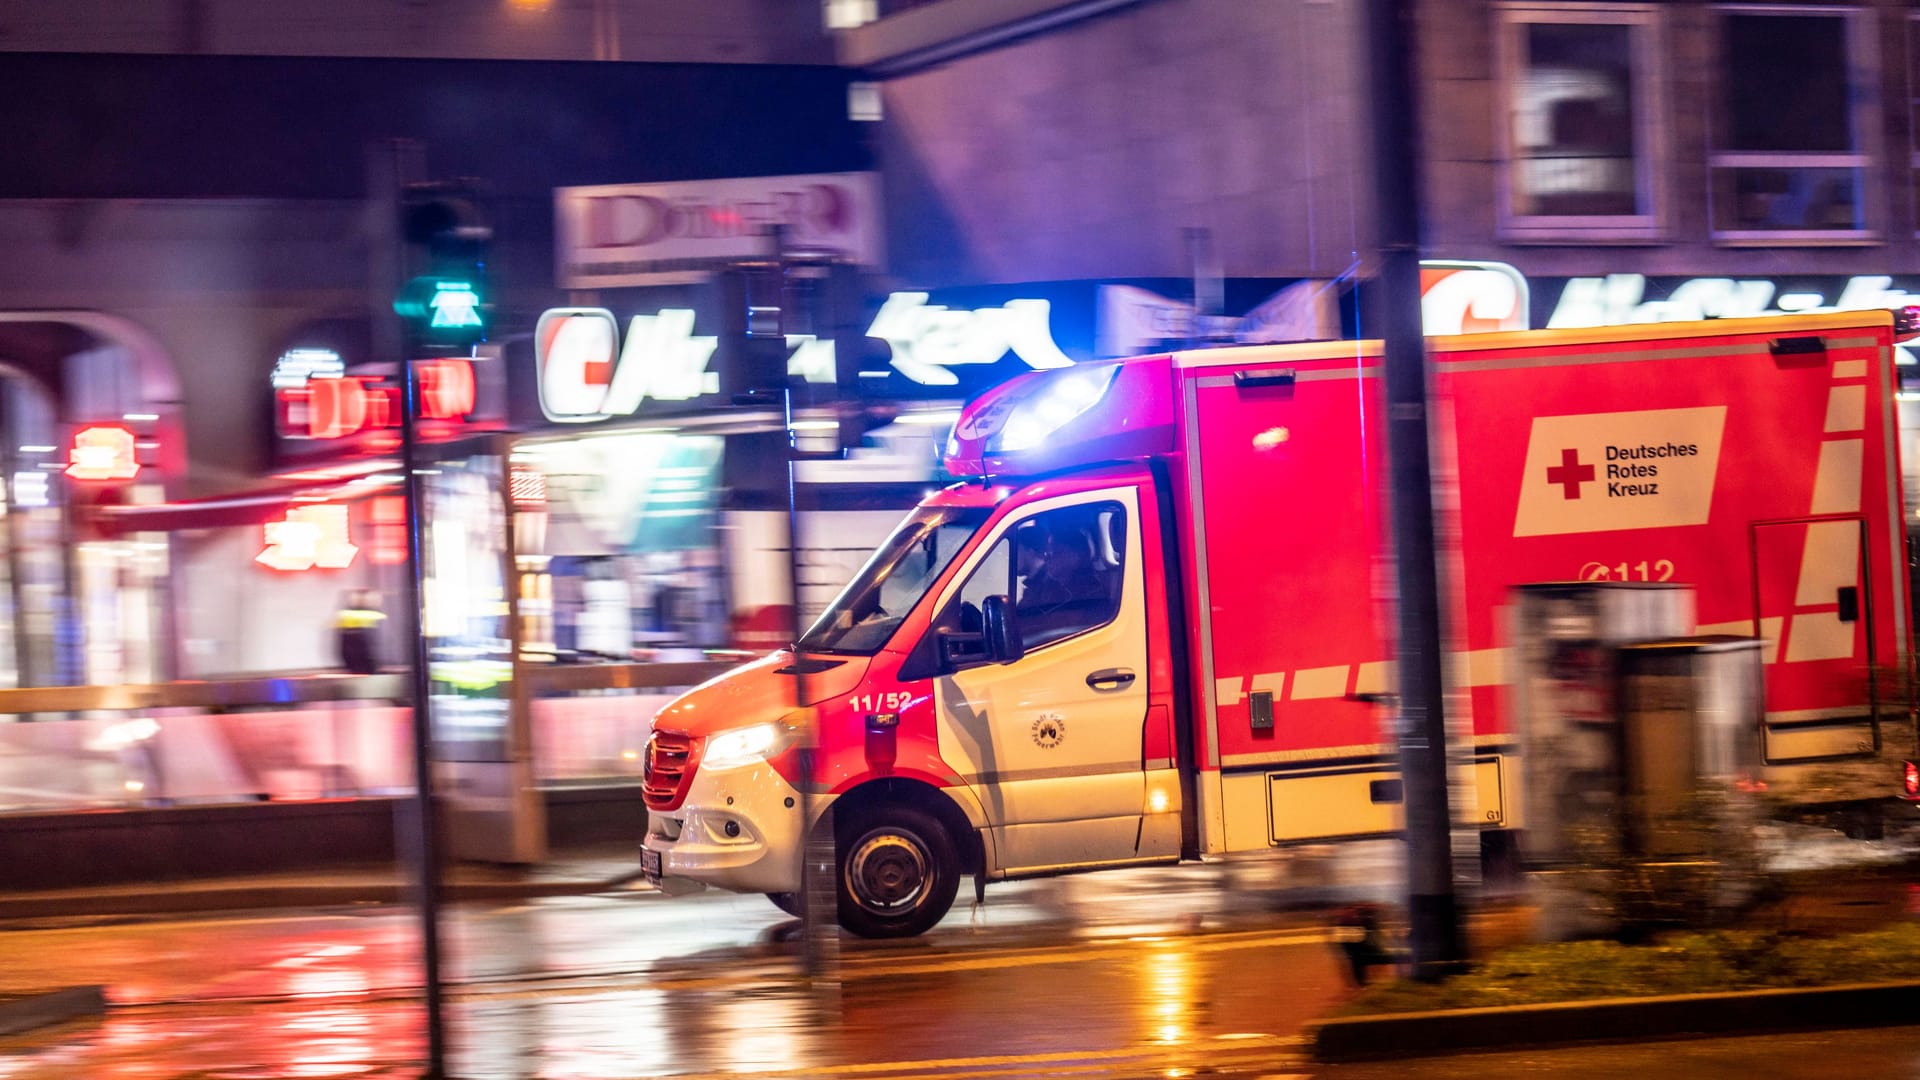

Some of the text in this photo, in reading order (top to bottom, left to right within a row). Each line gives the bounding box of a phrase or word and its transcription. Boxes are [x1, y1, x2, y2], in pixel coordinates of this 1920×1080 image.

[1605, 442, 1698, 460] Deutsches
[1607, 464, 1658, 479] Rotes
[1608, 482, 1659, 497] Kreuz
[1614, 559, 1675, 582] 112
[848, 691, 913, 713] 11/52
[1486, 810, 1500, 821] G1
